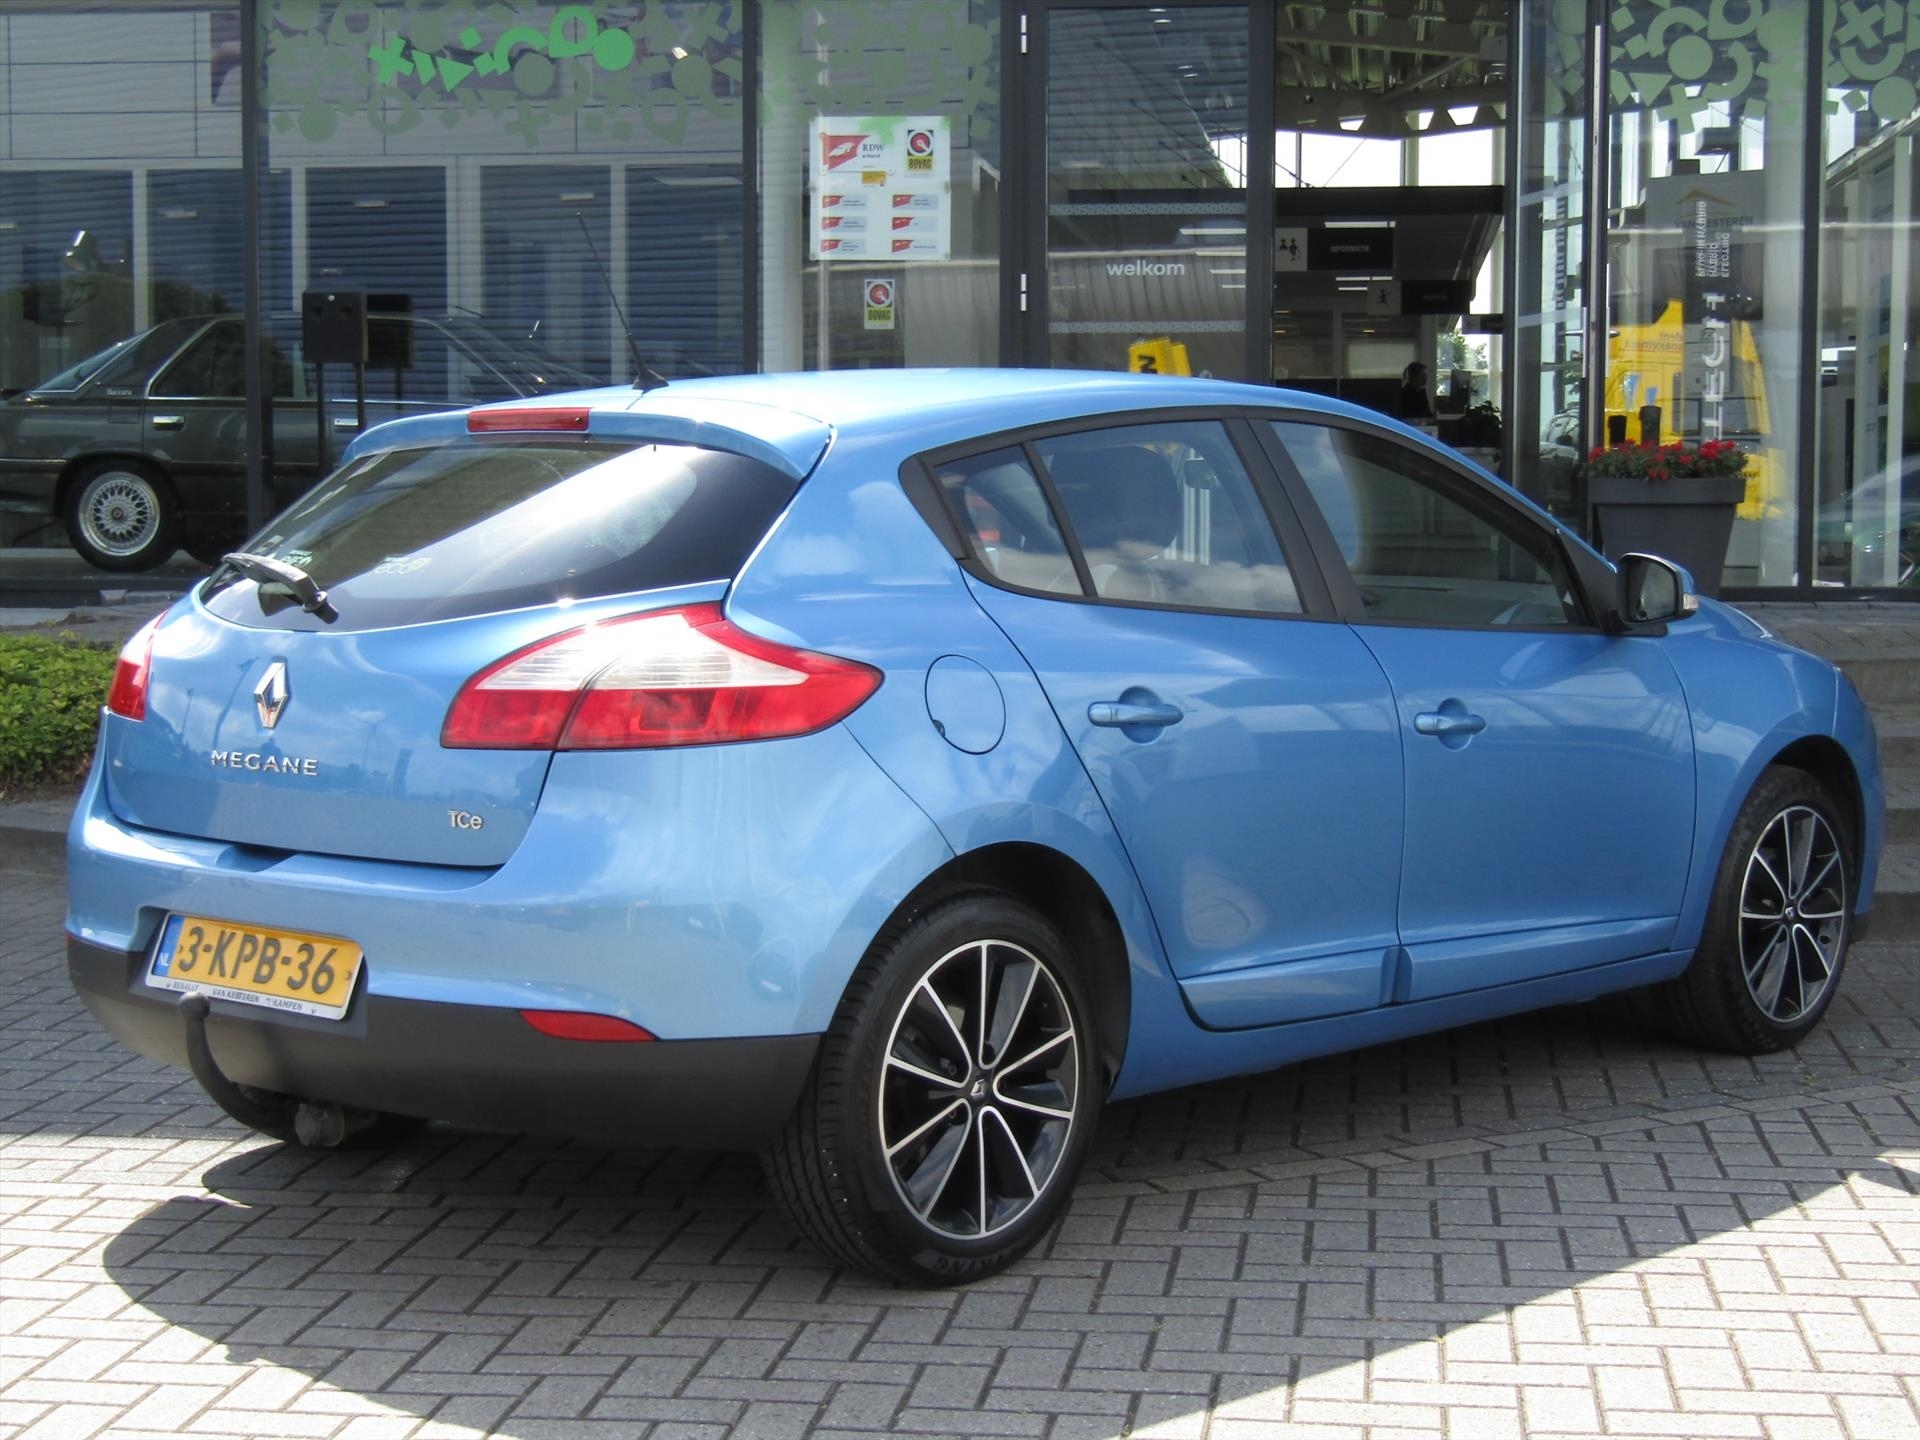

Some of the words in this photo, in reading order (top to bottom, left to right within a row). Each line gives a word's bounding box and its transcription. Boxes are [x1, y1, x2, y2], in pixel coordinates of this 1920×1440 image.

[862, 143, 885, 152] RDW
[908, 158, 932, 170] BOVAG
[1674, 219, 1696, 229] VAN
[1698, 216, 1753, 229] ESTEREN
[1106, 259, 1186, 277] welkom
[868, 309, 891, 321] BOVAG
[210, 750, 319, 777] MEGANE
[447, 810, 483, 830] TCe
[157, 952, 171, 967] NL
[178, 926, 338, 994] 3-KPB-36
[212, 988, 226, 997] VAN
[226, 991, 260, 1003] KESTEREN
[272, 998, 303, 1011] KAMPEN
